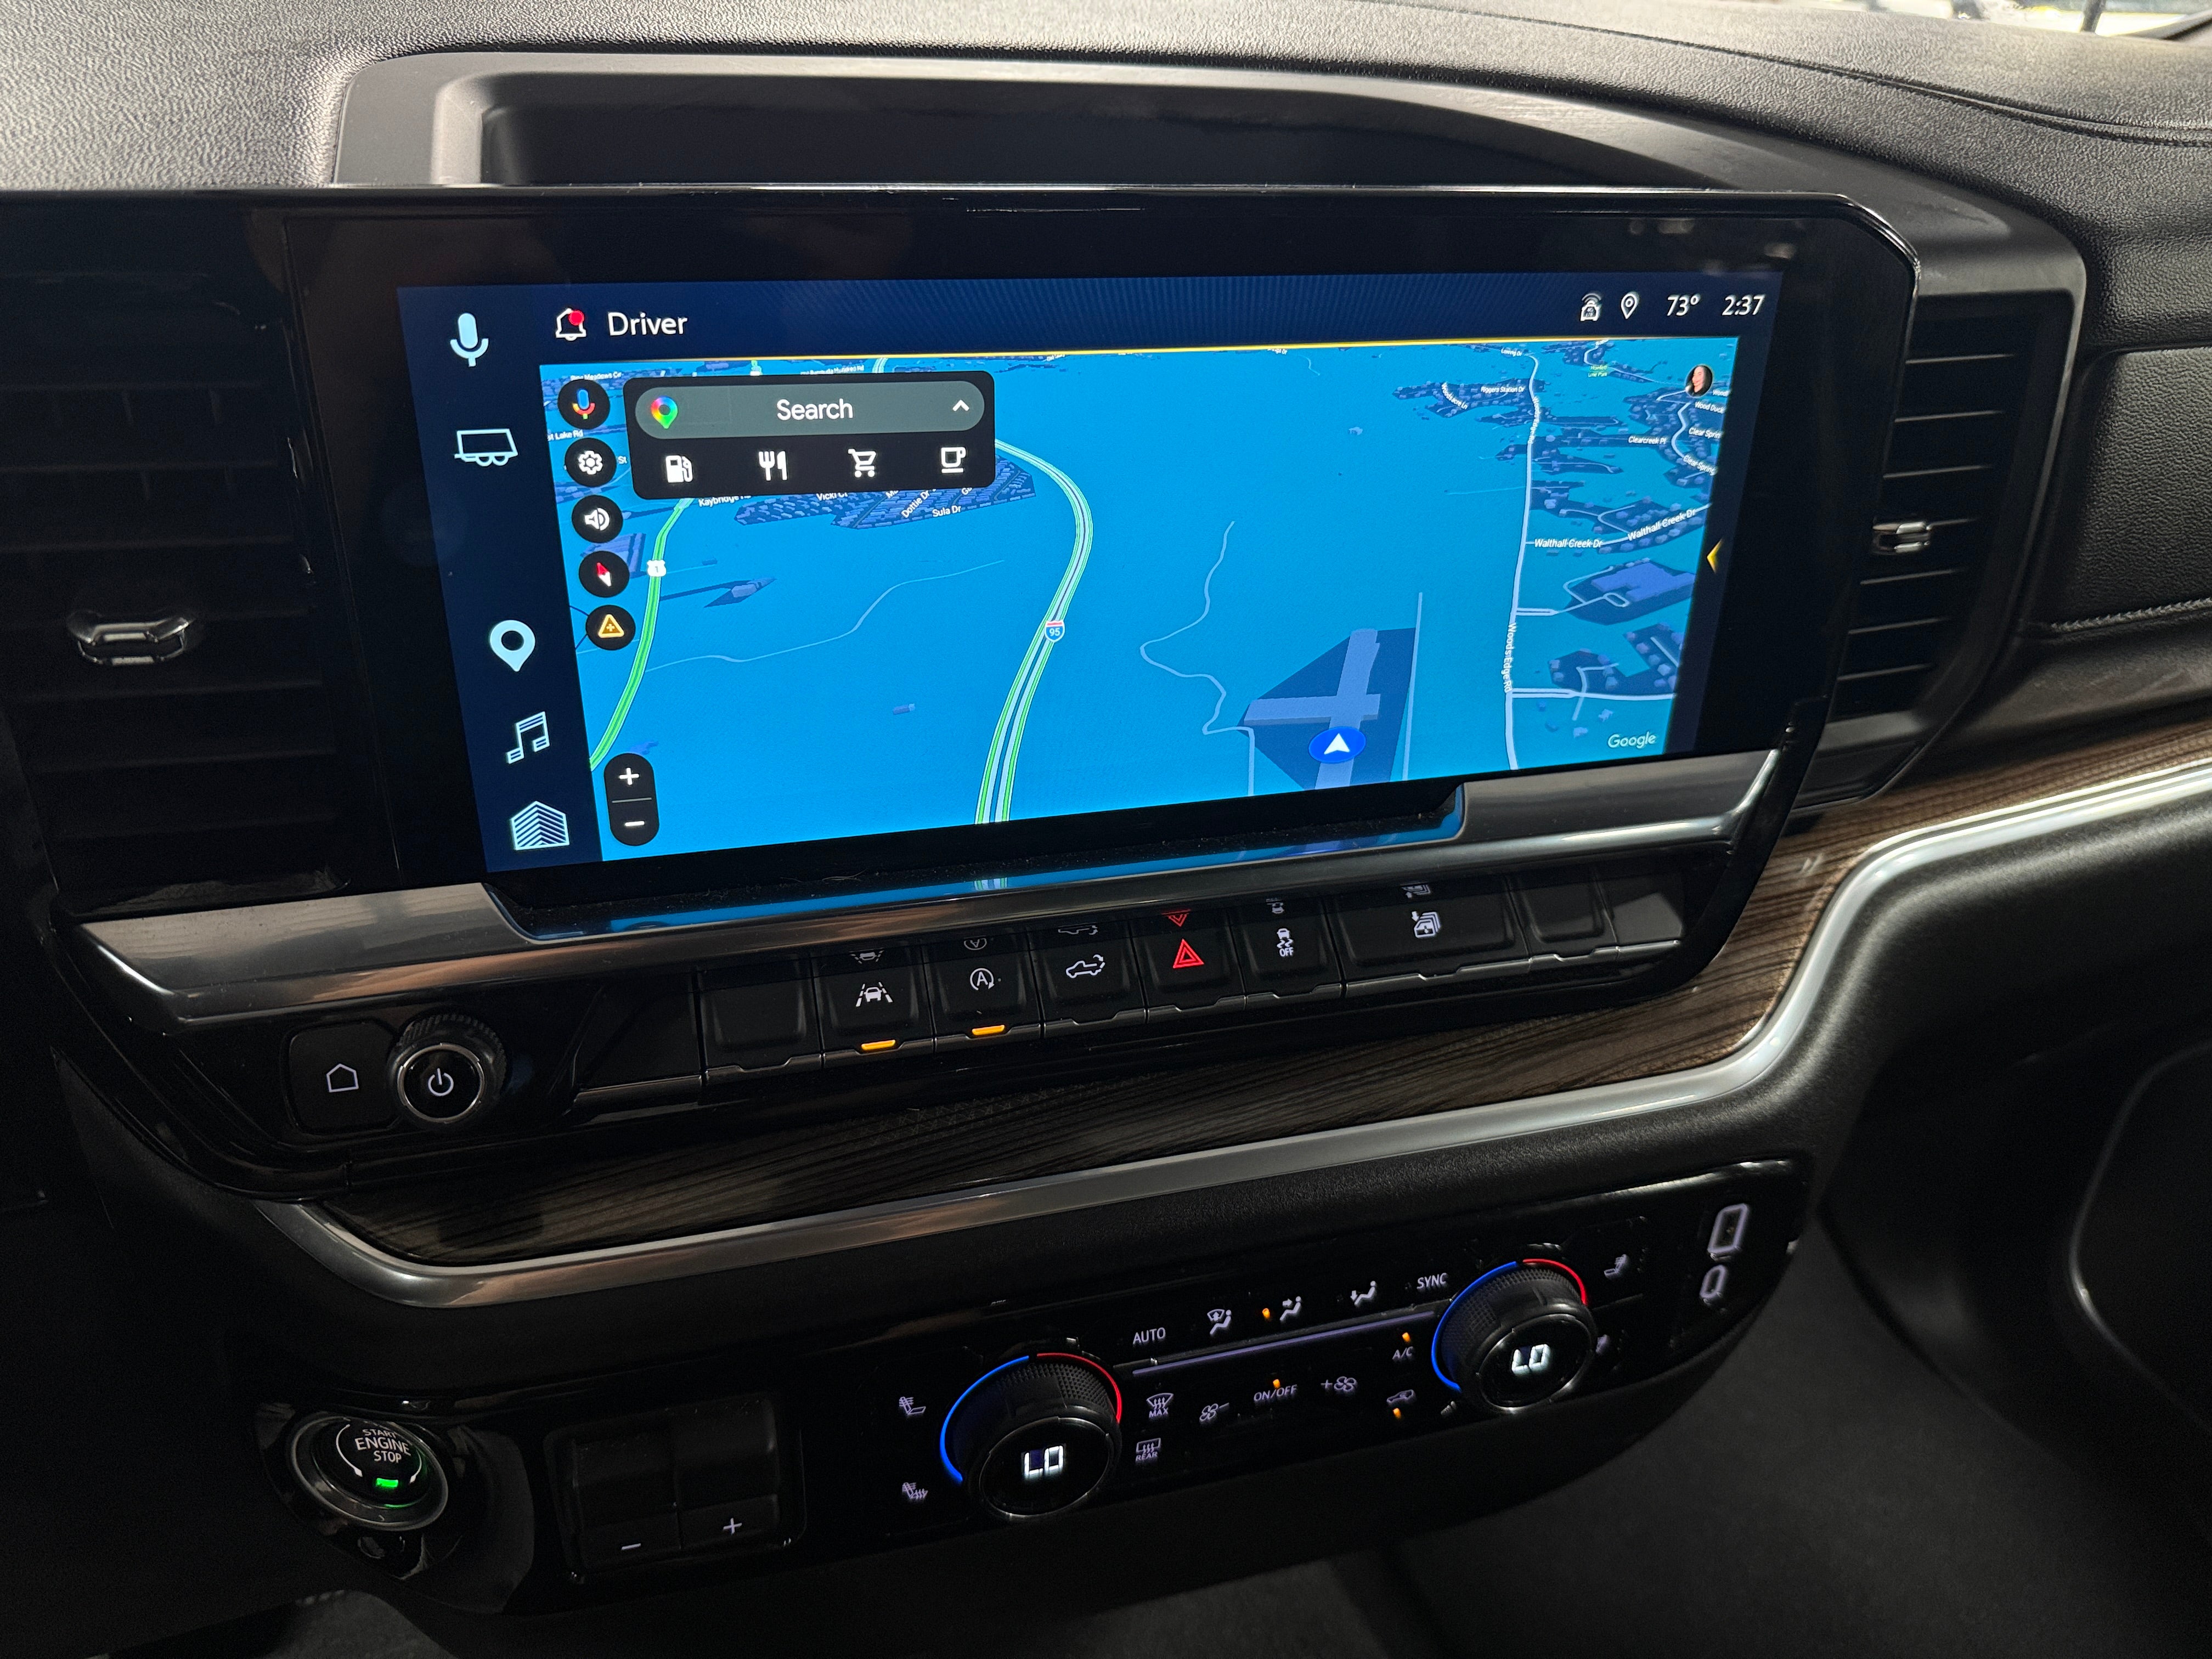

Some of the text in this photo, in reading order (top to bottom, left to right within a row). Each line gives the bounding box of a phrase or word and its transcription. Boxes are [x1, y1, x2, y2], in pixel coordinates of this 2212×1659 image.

[1722, 294, 1765, 317] 2:37
[608, 311, 687, 336] Driver
[776, 398, 853, 421] Search
[1461, 401, 1469, 410] Ln
[573, 429, 583, 438] Rd
[1689, 427, 1704, 436] Clear
[901, 489, 932, 518] Dottie Dr
[932, 505, 961, 518] Sula Dr
[1627, 507, 1697, 541] Walthall Creek Dr
[1534, 538, 1603, 548] Walthall Creek Dr
[1049, 628, 1061, 637] 95
[1501, 622, 1518, 693] Woods Edge Rd
[1607, 731, 1657, 749] Google
[1279, 947, 1294, 957] OFF
[1417, 1272, 1448, 1290] SYNC
[1132, 1327, 1166, 1346] AUTO
[1392, 1346, 1415, 1361] A/C
[1253, 1384, 1298, 1403] ON/OFF
[1149, 1406, 1169, 1418] MAX
[362, 1429, 397, 1439] START
[354, 1437, 411, 1456] ENGINE
[374, 1450, 402, 1464] STOP
[1135, 1451, 1158, 1462] REAR
